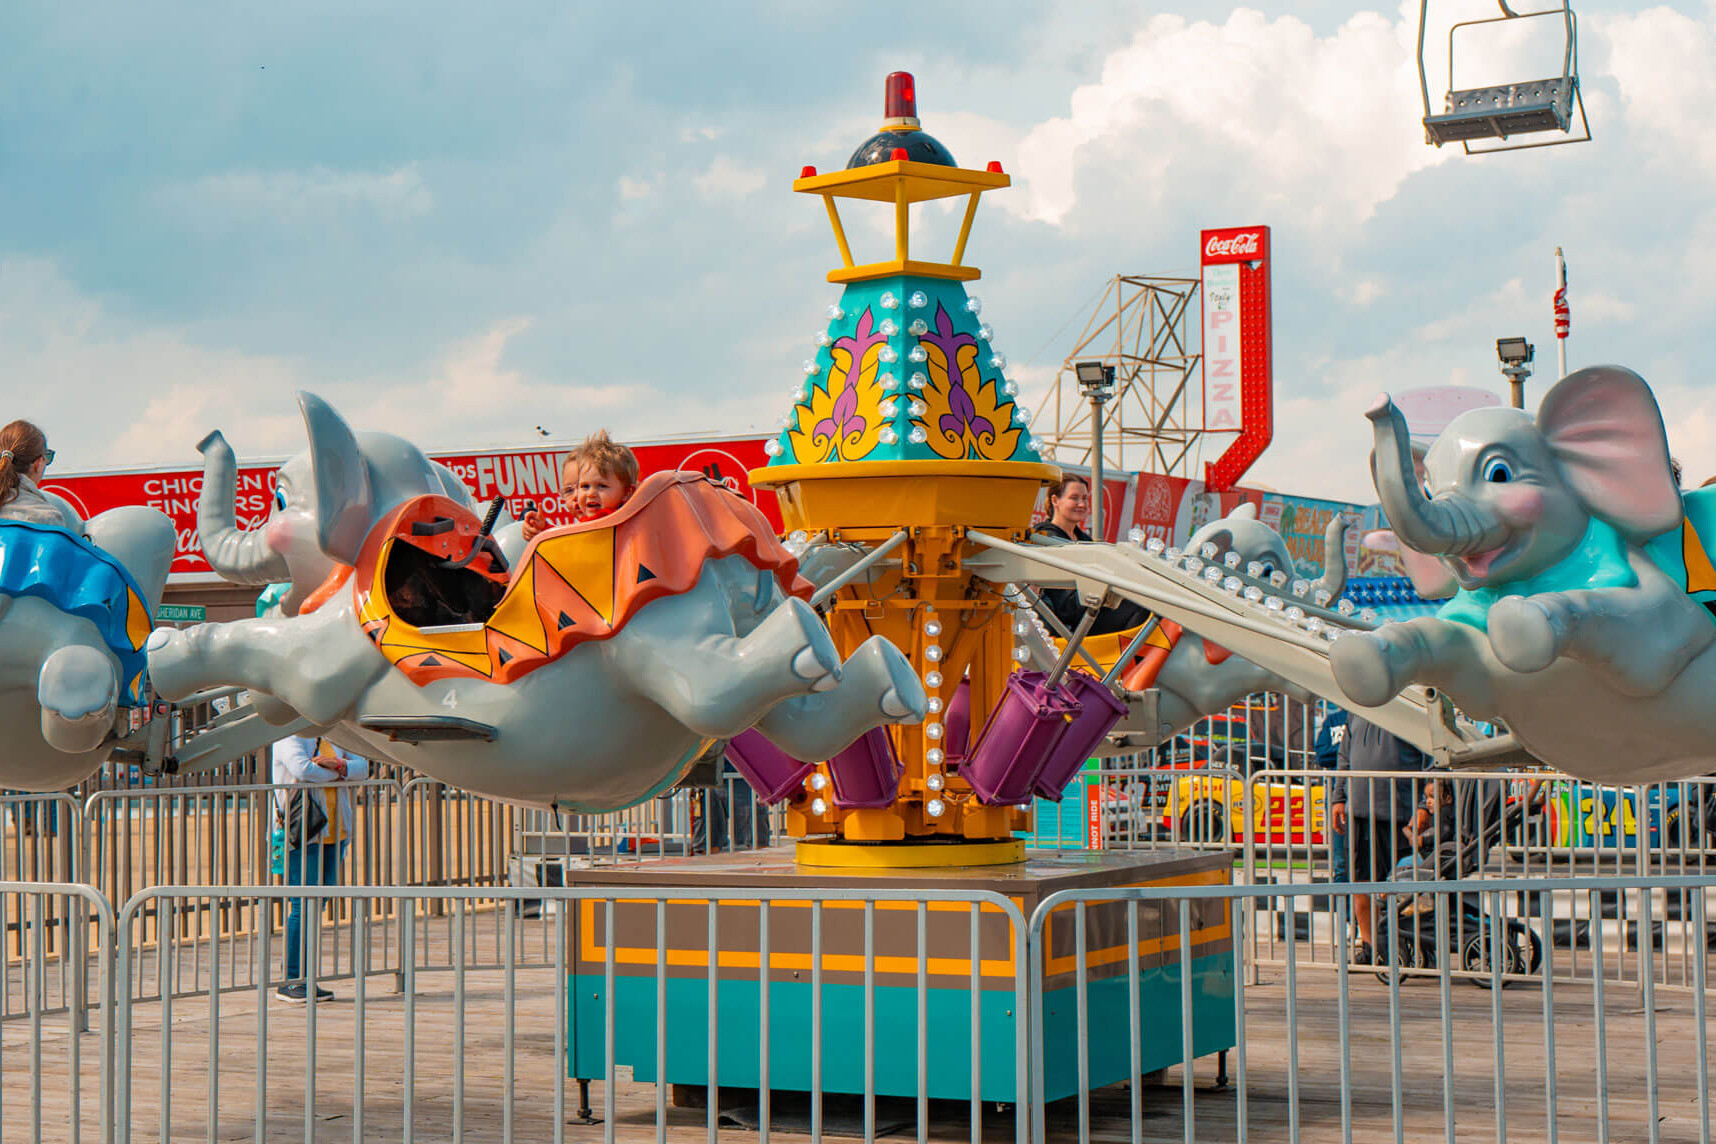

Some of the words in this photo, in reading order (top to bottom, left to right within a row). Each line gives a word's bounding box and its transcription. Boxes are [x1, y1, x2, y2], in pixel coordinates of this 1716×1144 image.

[1206, 233, 1259, 256] Coca-Cola
[1211, 312, 1235, 426] PIZZA
[446, 461, 477, 479] ips
[476, 453, 569, 497] FUNN
[143, 474, 263, 496] CHICEN
[441, 688, 458, 709] 4
[1260, 796, 1305, 827] 22
[1581, 798, 1637, 835] 24
